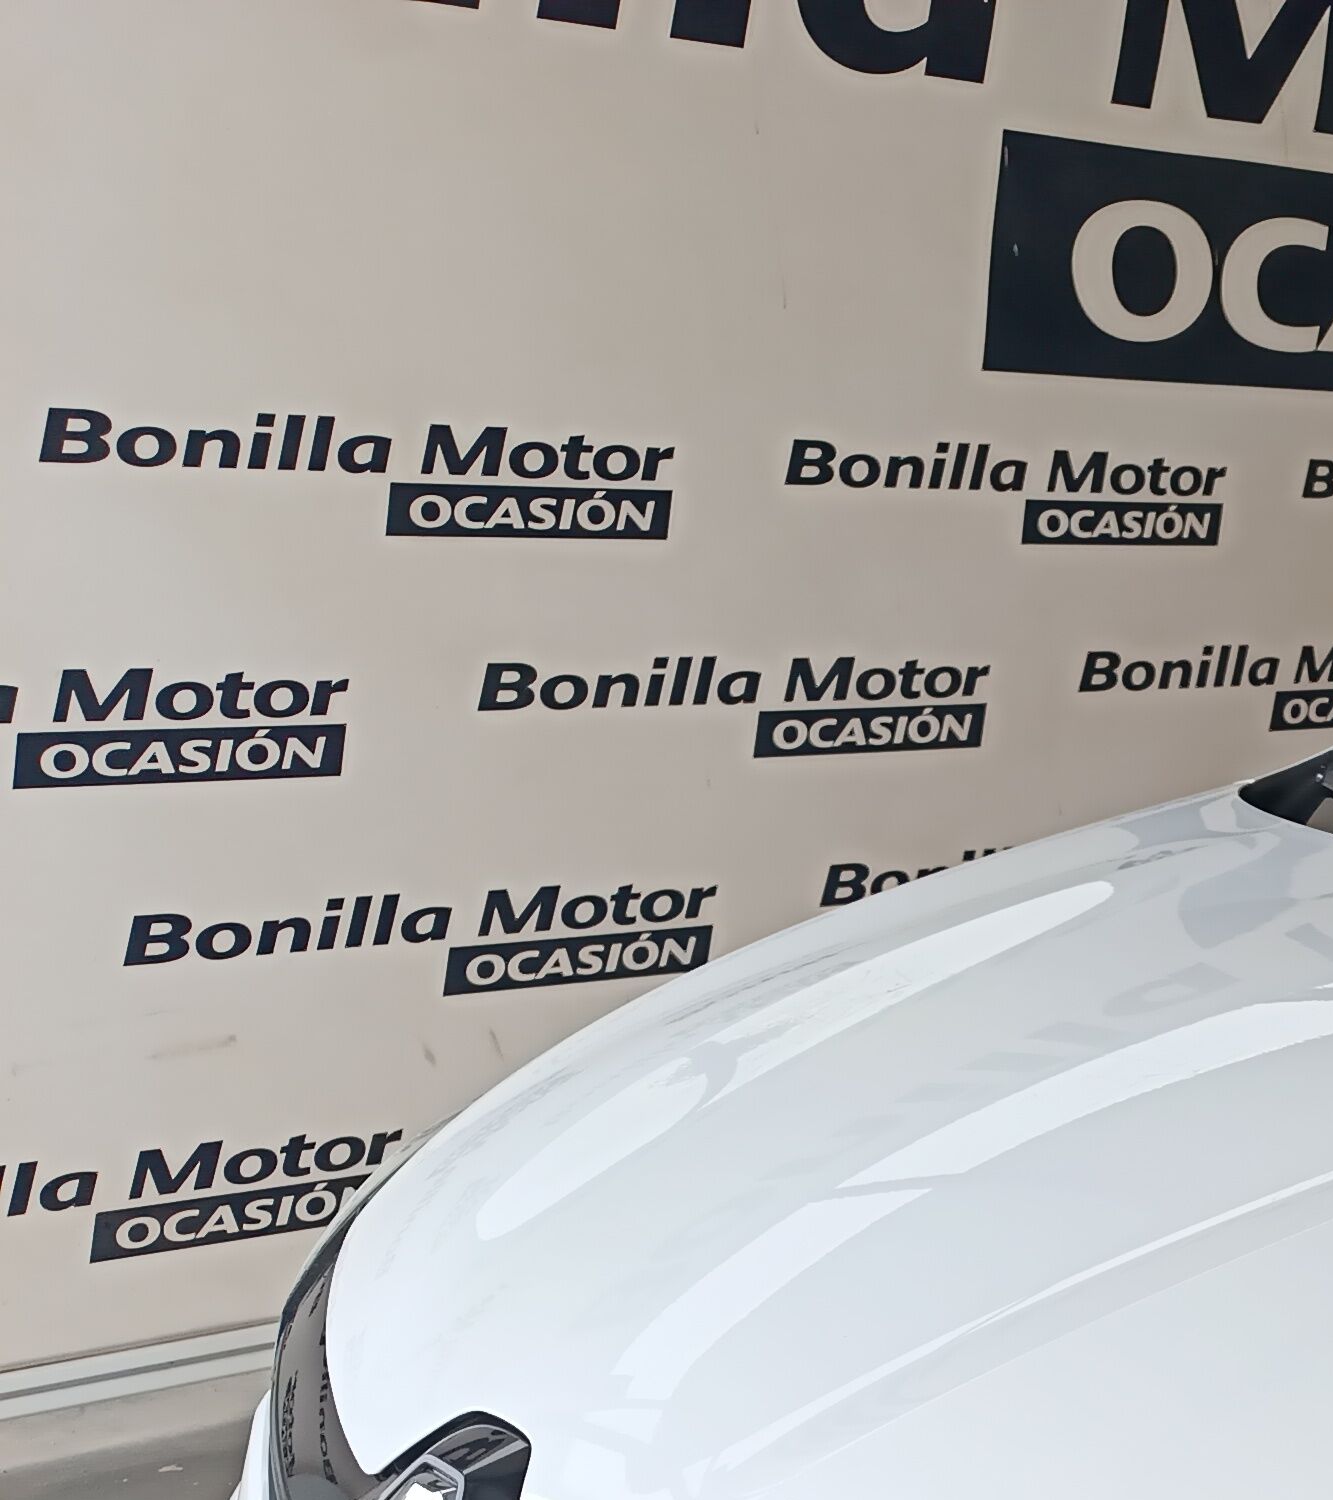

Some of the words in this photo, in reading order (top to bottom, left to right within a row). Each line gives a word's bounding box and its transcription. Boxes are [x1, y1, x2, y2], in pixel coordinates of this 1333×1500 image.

[39, 407, 392, 474] Bonilla
[420, 424, 675, 483] Motor
[785, 439, 1028, 492] Bonilla
[1047, 450, 1227, 496] Motor
[408, 490, 657, 533] OCASIÓN
[1037, 505, 1210, 538] OCASIÓN
[478, 656, 761, 710] Bonilla
[785, 656, 990, 701] Motor
[1079, 644, 1280, 692] Bonilla
[53, 668, 349, 723] Motor
[40, 729, 326, 778] OCASIÓN
[772, 708, 972, 749] OCASIÓN
[122, 893, 451, 966] Bonilla
[478, 884, 717, 936] Motor
[465, 934, 696, 986] OCASIÓN
[0, 1161, 98, 1217] la
[129, 1129, 403, 1199] Motor
